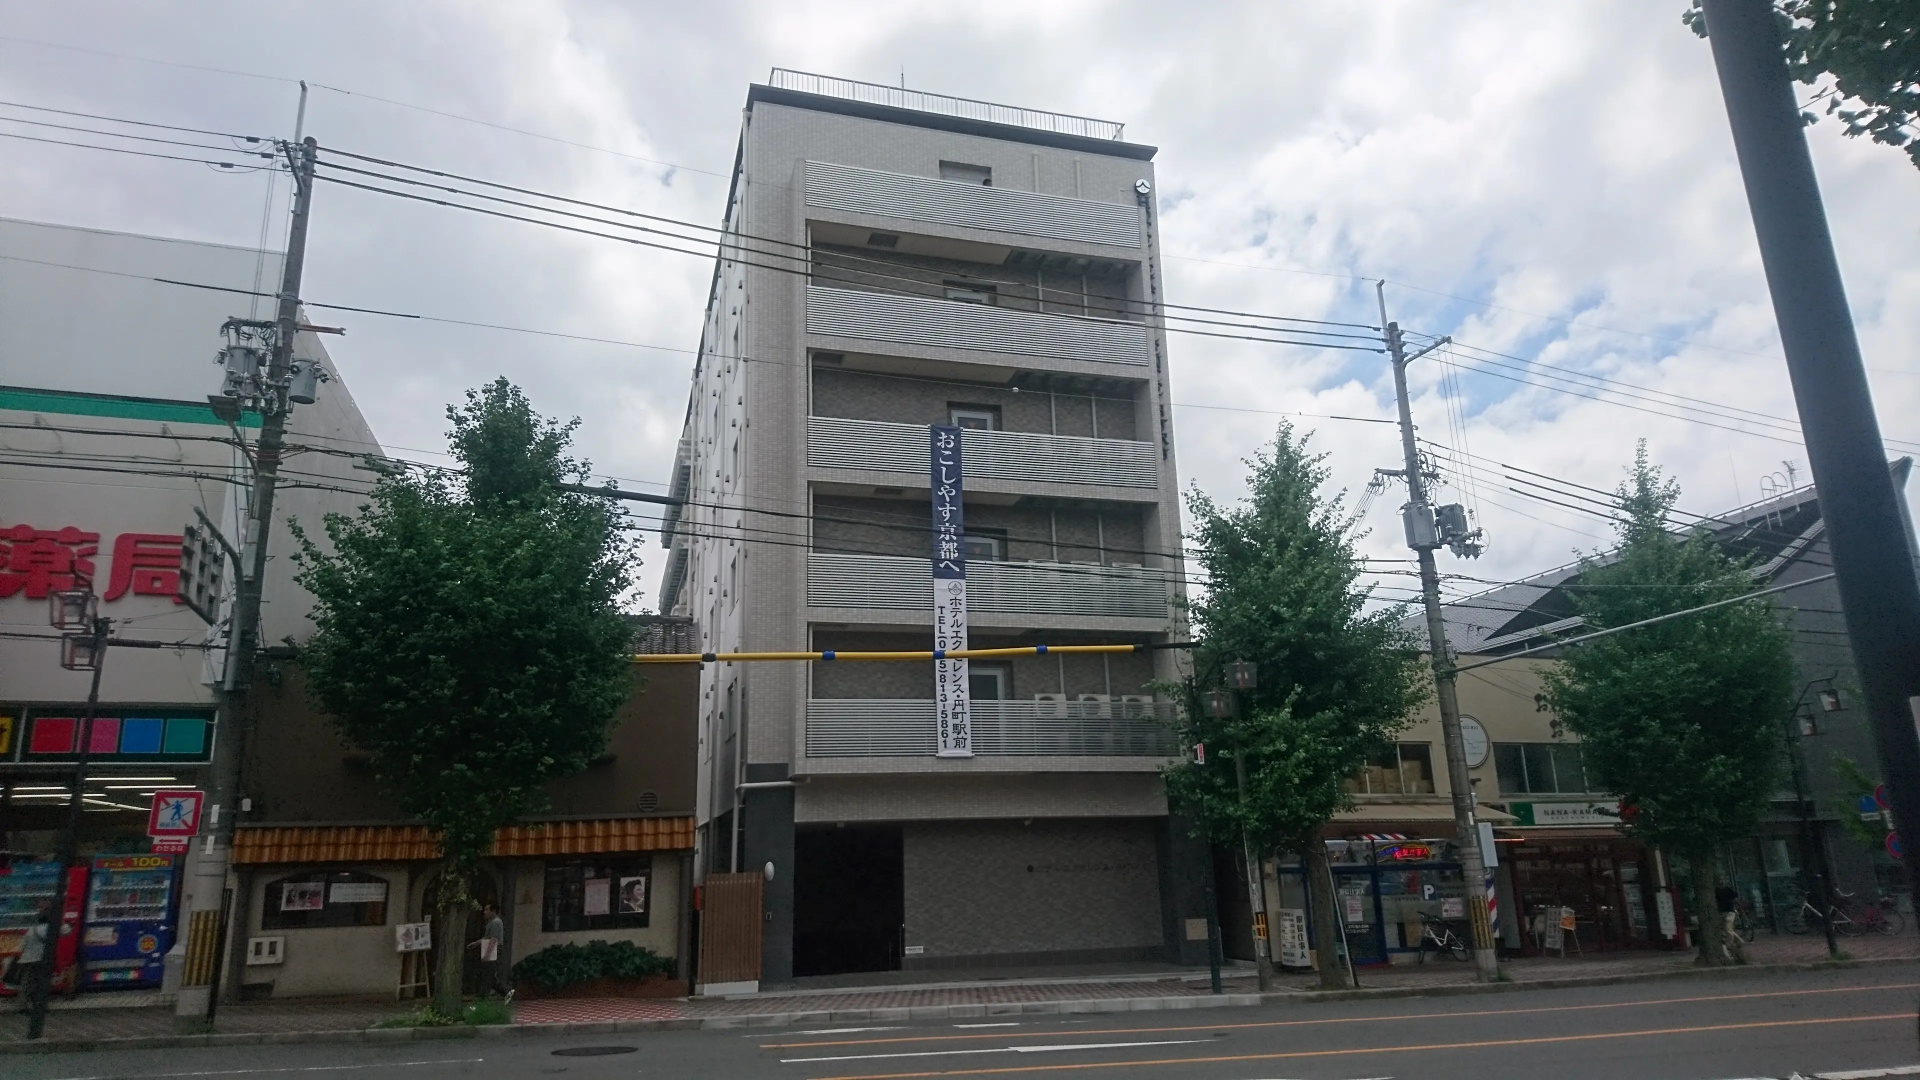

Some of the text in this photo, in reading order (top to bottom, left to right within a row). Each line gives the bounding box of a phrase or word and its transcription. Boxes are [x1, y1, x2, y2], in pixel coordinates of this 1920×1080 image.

[937, 432, 960, 572] おこしやす京都へ
[0, 523, 184, 604] 薬局
[937, 606, 949, 749] TEL(05)813-5861
[132, 857, 169, 867] 100円
[1423, 884, 1435, 900] P
